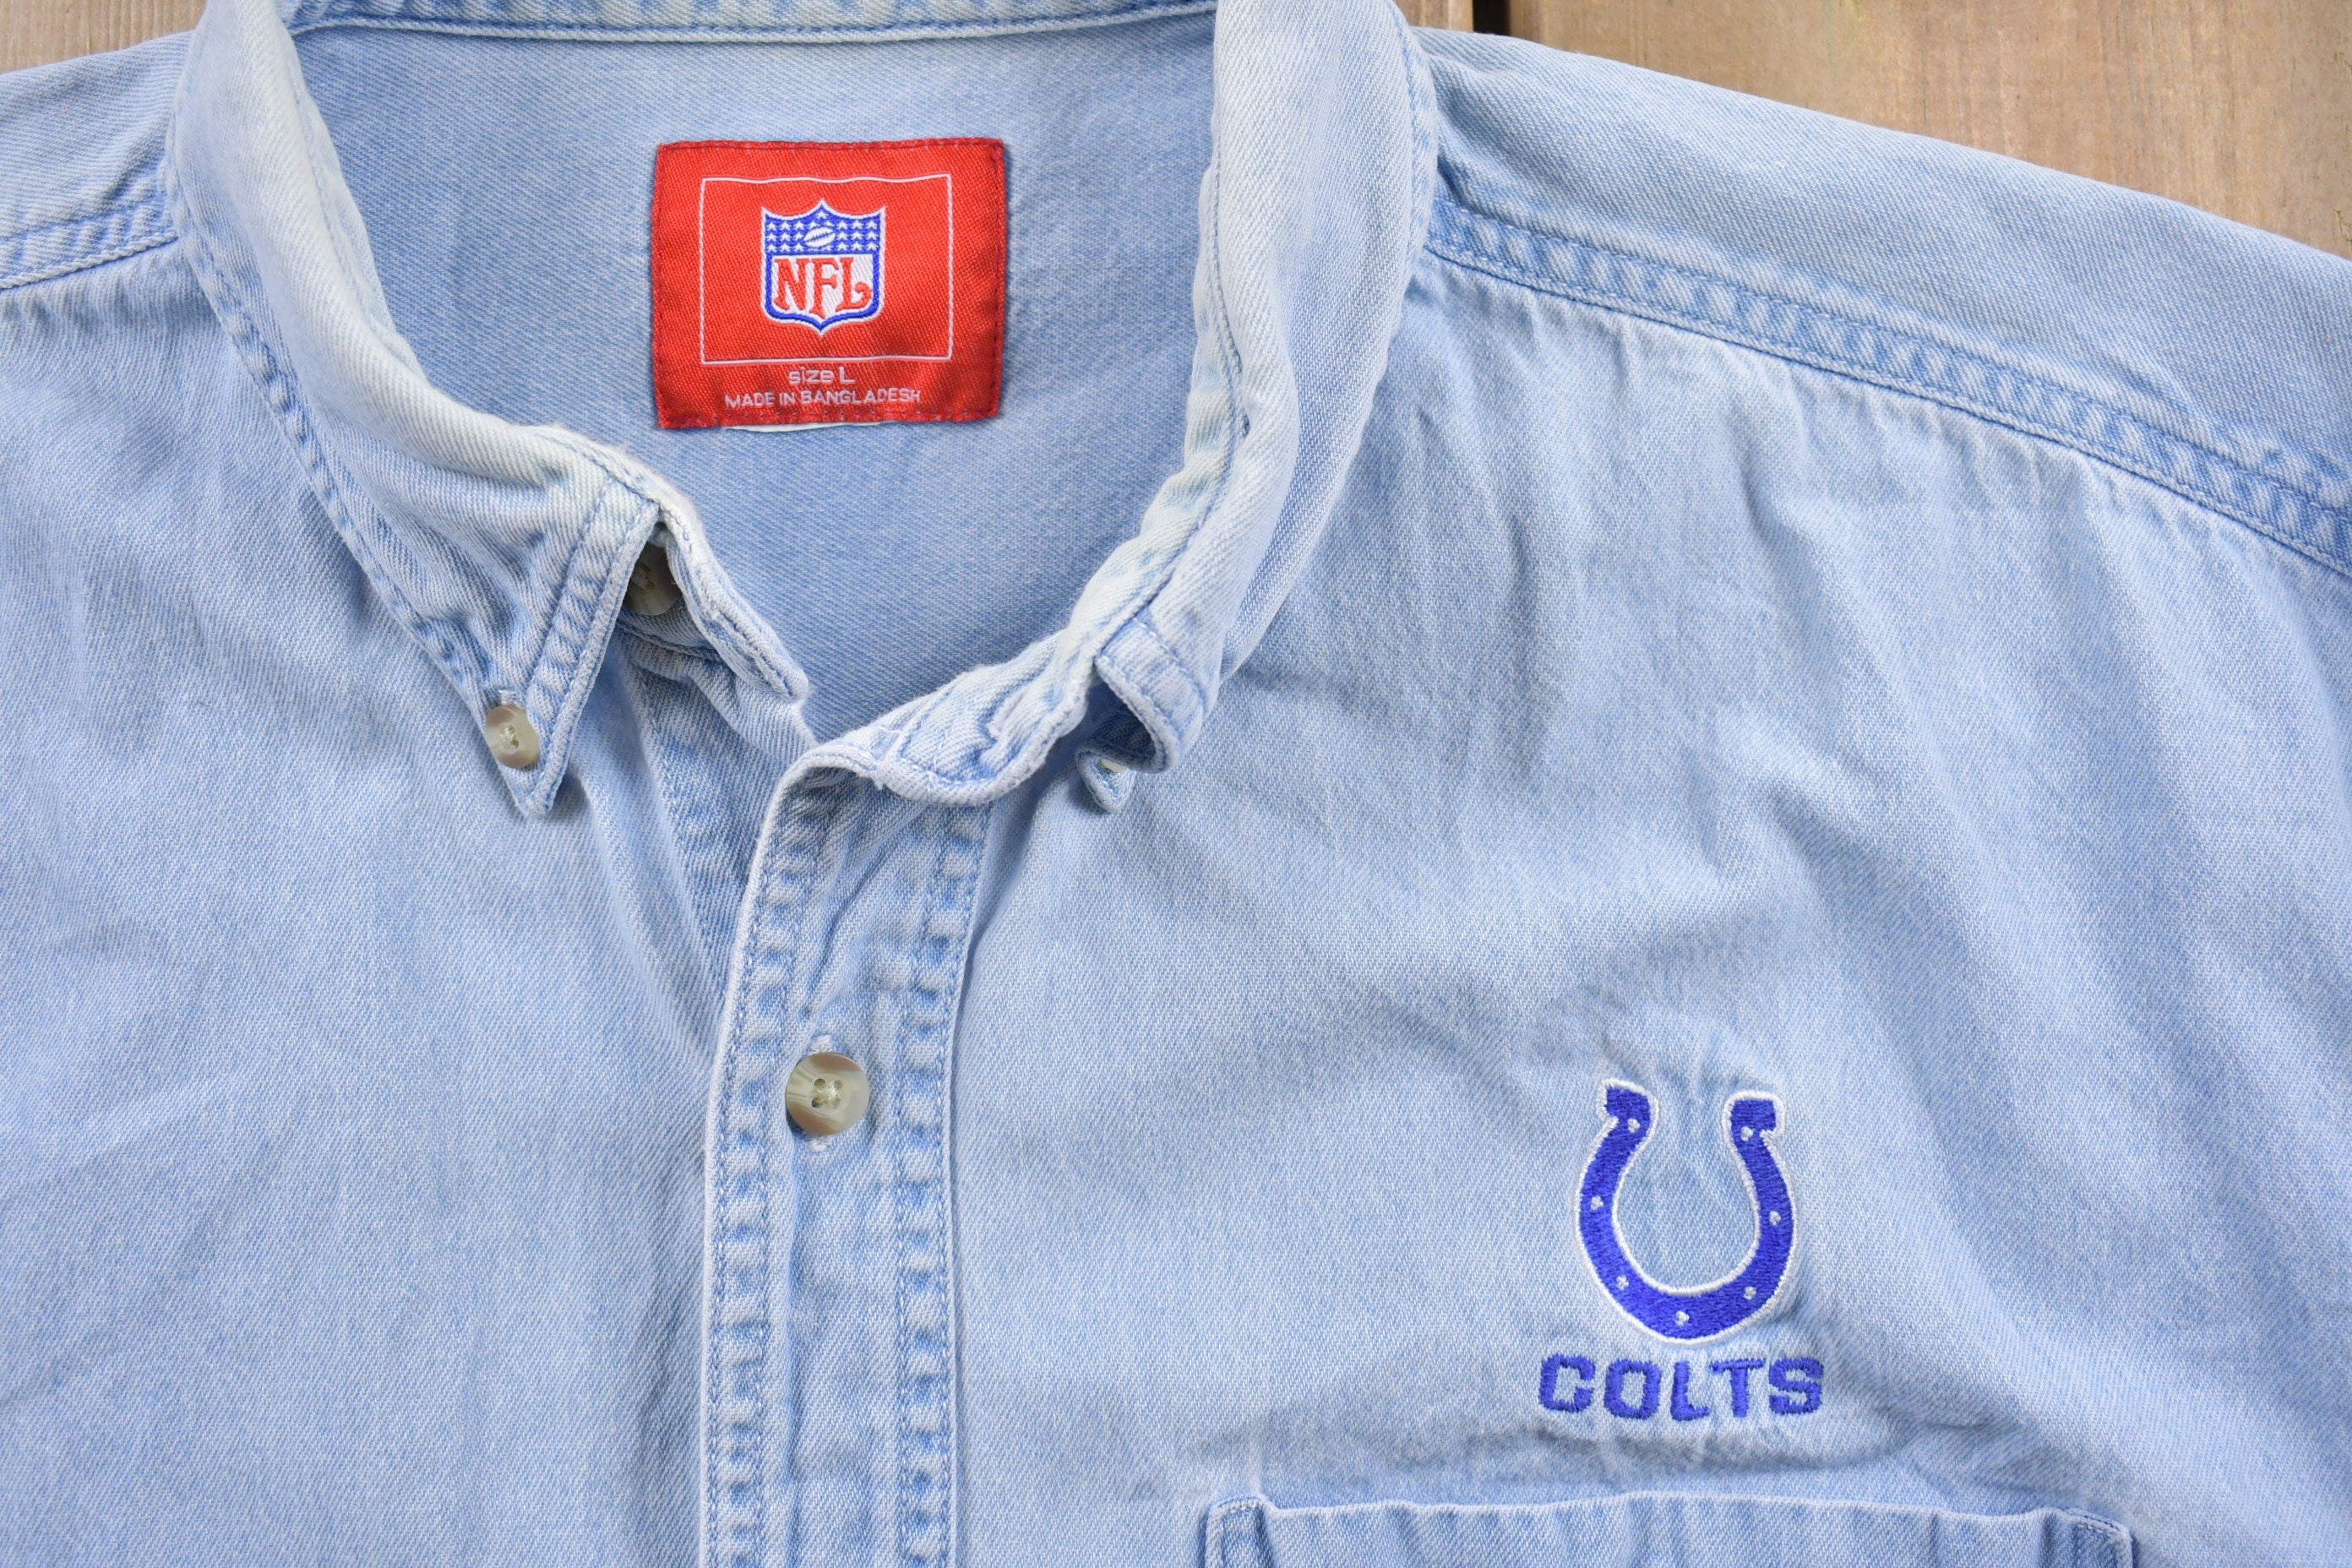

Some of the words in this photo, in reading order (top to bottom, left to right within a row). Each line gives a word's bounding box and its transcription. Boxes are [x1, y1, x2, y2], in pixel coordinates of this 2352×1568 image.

[773, 257, 873, 318] NFL
[788, 367, 834, 384] size
[839, 366, 855, 384] L
[725, 392, 775, 408] MADE
[779, 391, 797, 406] IN
[801, 387, 921, 406] BANGLADESH
[1538, 1353, 1824, 1421] COLTS
